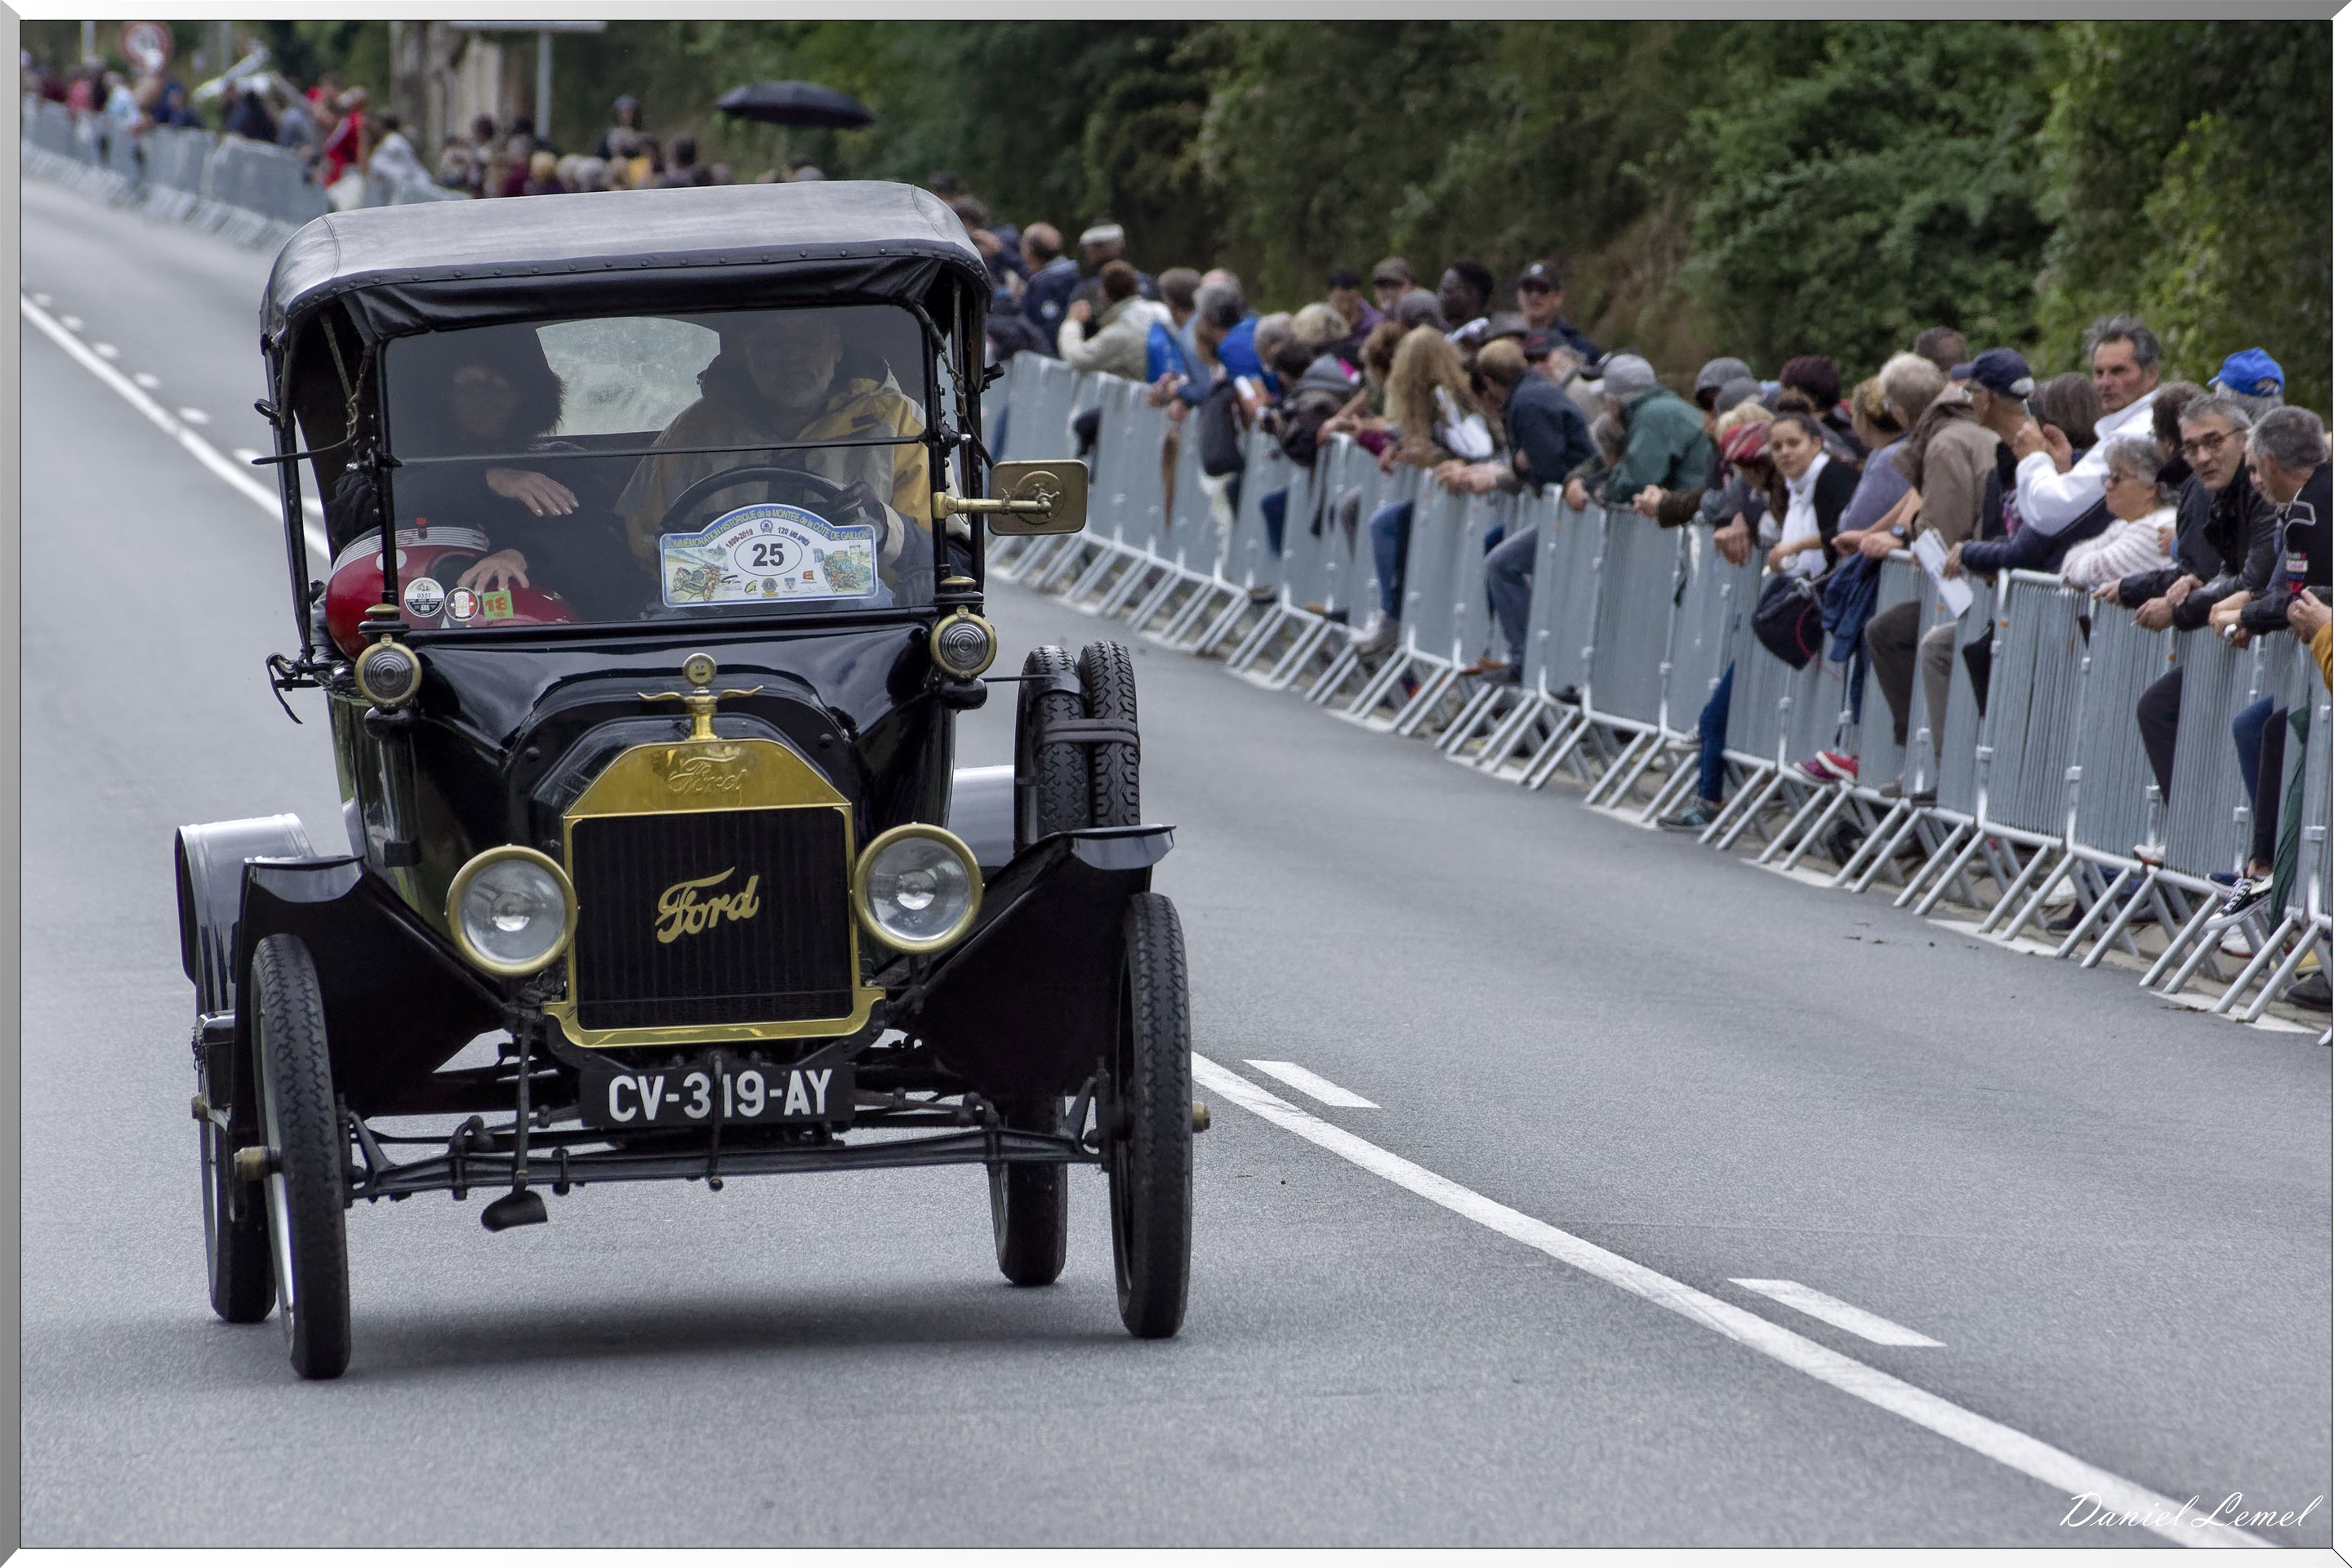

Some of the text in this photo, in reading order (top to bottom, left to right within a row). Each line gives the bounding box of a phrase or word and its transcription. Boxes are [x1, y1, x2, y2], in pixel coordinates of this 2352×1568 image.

[719, 510, 756, 533] HISTORIQUE
[757, 510, 765, 518] de
[765, 509, 772, 518] la
[800, 516, 807, 525] de
[807, 519, 813, 528] la
[813, 522, 831, 537] CÔTE
[830, 531, 840, 540] DE
[840, 530, 869, 540] GAILLON
[725, 528, 754, 549] 1899-2019
[778, 526, 789, 535] 120
[752, 542, 785, 567] 25
[668, 755, 746, 795] Ford
[655, 866, 760, 943] Ford
[608, 1068, 833, 1122] CV-319-AY
